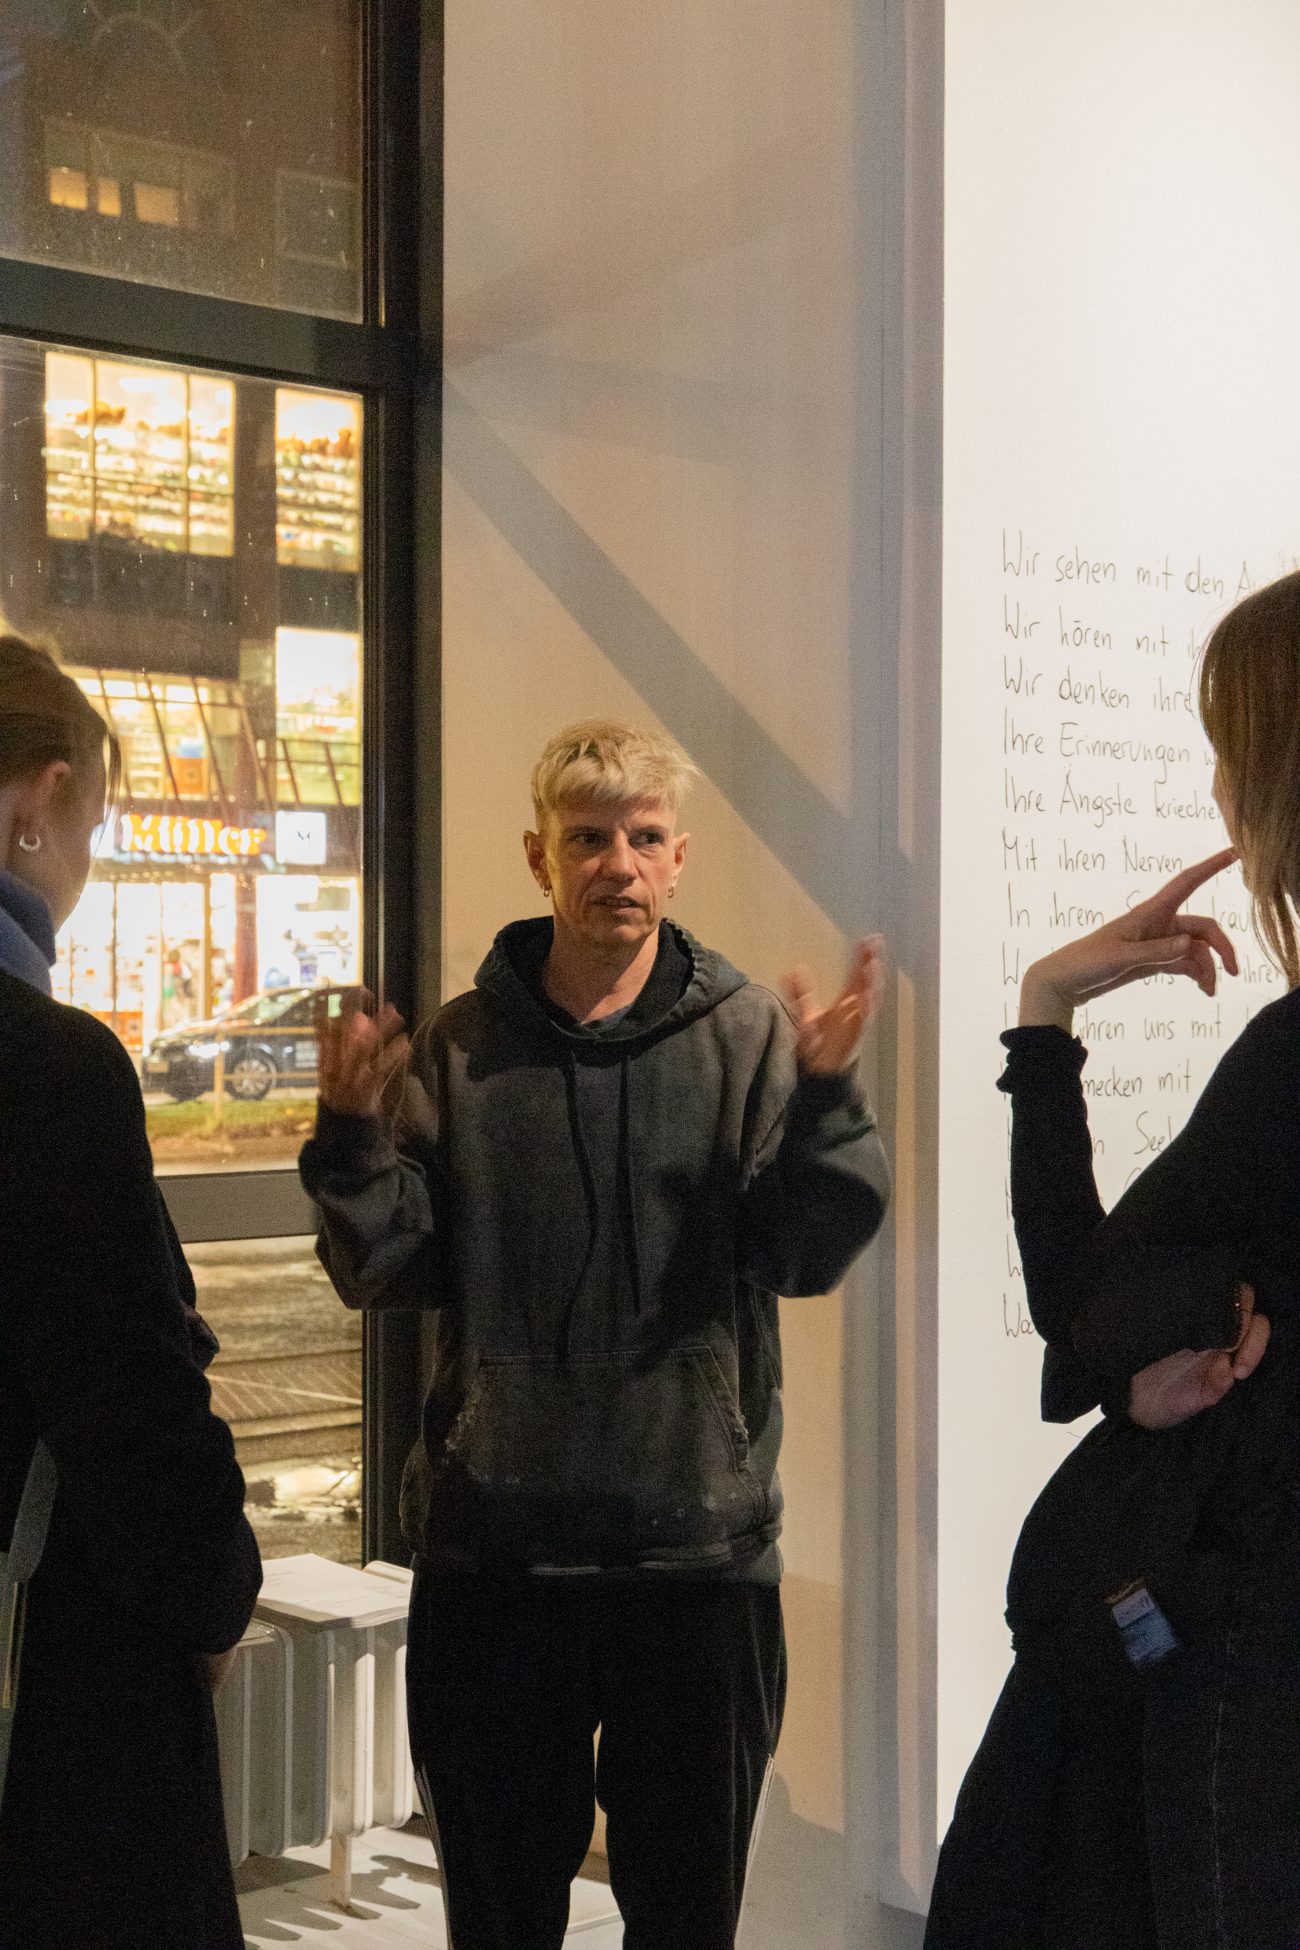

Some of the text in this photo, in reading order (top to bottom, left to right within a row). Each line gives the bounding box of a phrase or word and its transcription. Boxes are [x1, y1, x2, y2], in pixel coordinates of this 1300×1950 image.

[1003, 527, 1040, 577] Wir
[1055, 545, 1116, 584] sehen
[1136, 554, 1174, 592] mit
[1184, 555, 1224, 600] den
[1004, 594, 1041, 640] Wir
[1003, 654, 1043, 696] Wir
[1058, 664, 1129, 710] denken
[1003, 704, 1190, 785] Ihre Erinnerungen
[1003, 767, 1045, 814] Ihre
[1059, 763, 1138, 828] Ängste
[1002, 826, 1182, 874] Mit ihren Nerven
[1007, 881, 1030, 928] In
[1048, 890, 1105, 929] ihrem
[1143, 1017, 1176, 1041] uns
[1192, 1002, 1222, 1040] mit
[1083, 1058, 1192, 1098] mecken mit
[1133, 1110, 1173, 1155] Seel
